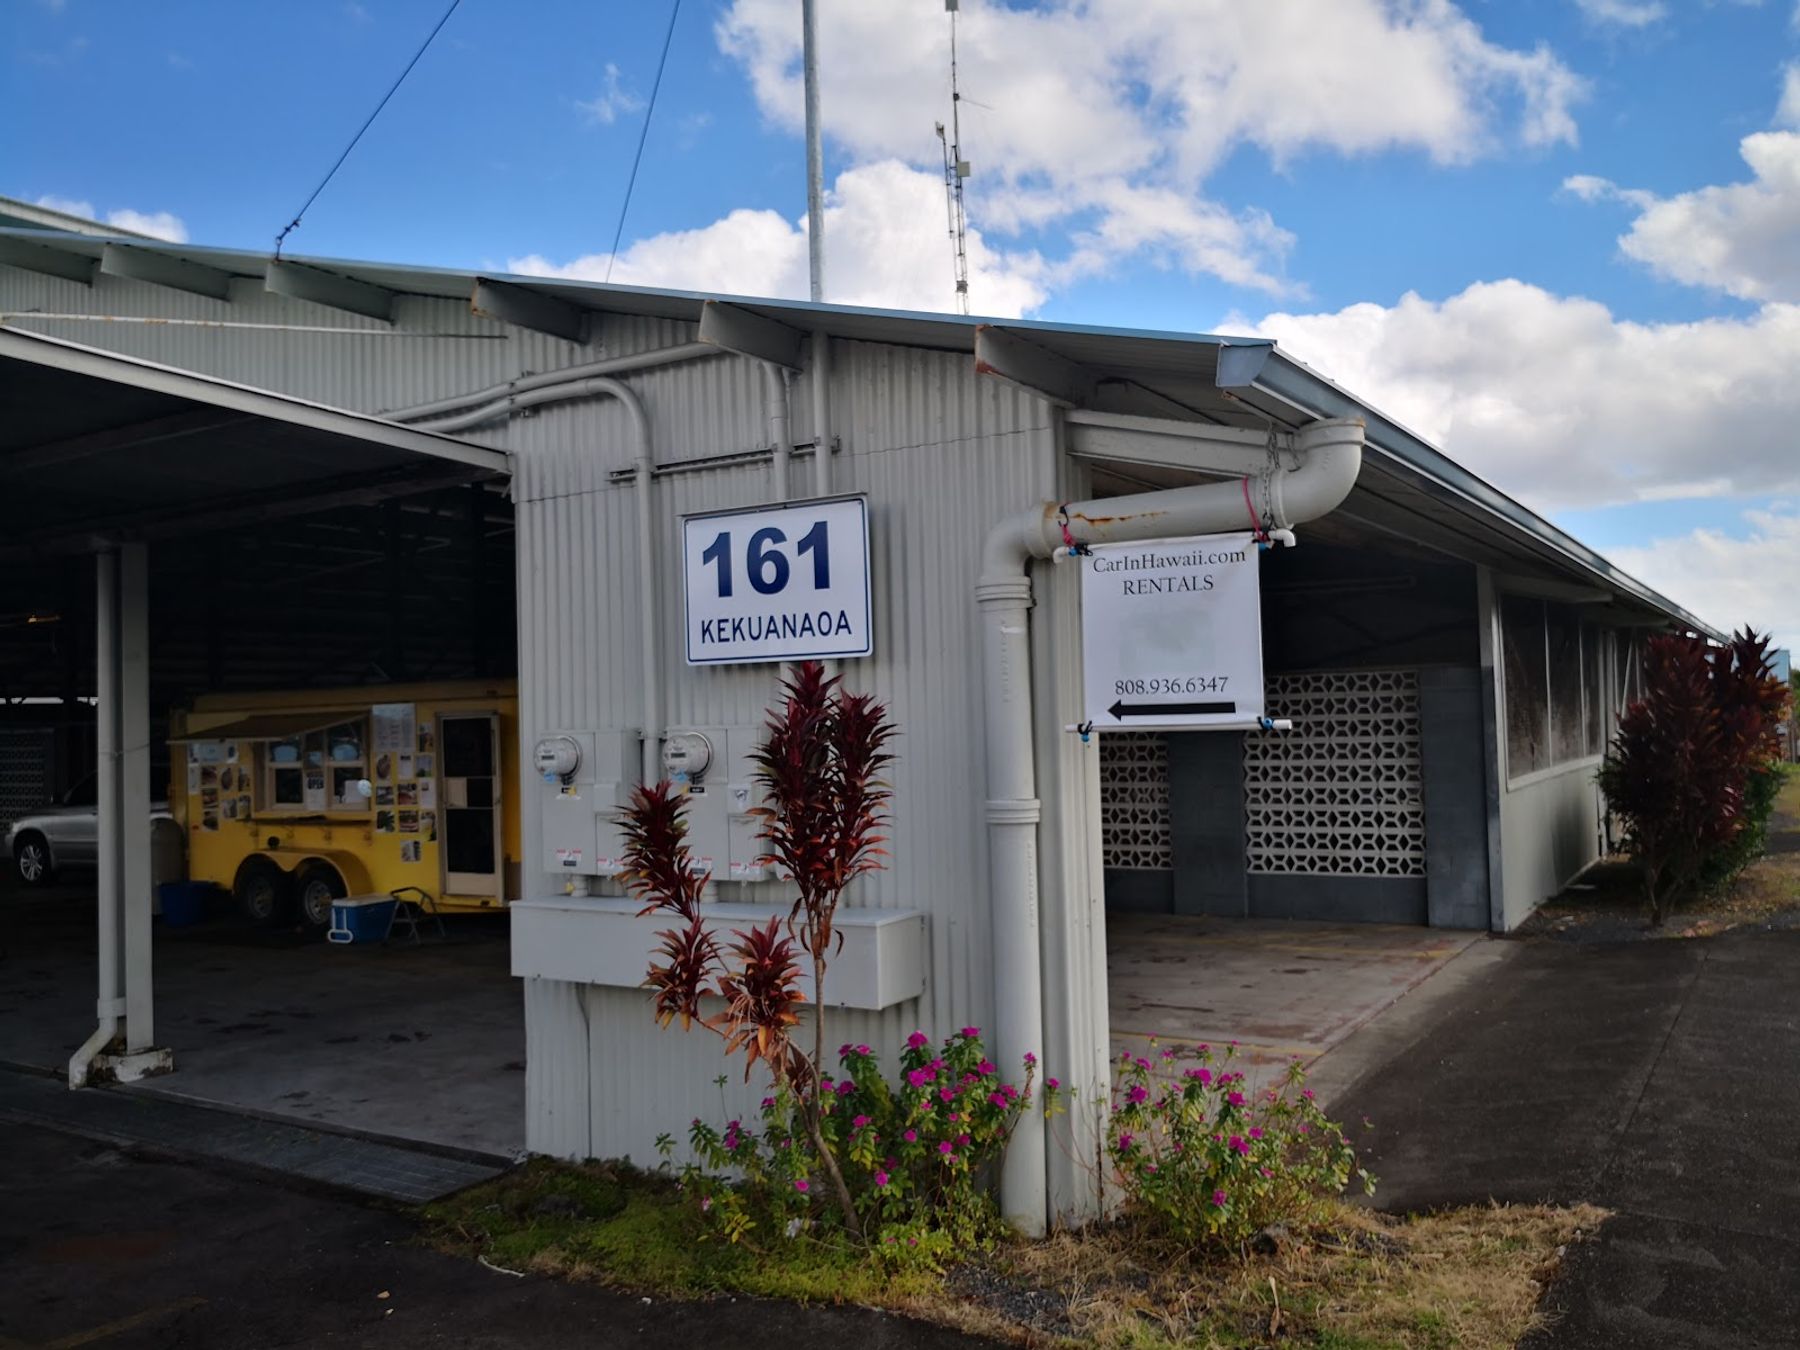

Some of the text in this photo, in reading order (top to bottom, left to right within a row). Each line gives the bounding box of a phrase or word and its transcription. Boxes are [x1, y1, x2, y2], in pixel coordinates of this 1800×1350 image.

[703, 521, 831, 597] 161
[1093, 550, 1246, 574] CarInHawaii.com
[1123, 575, 1214, 595] RENTALS
[702, 610, 852, 644] KEKUANAOA
[1115, 677, 1229, 695] 808.936.6347
